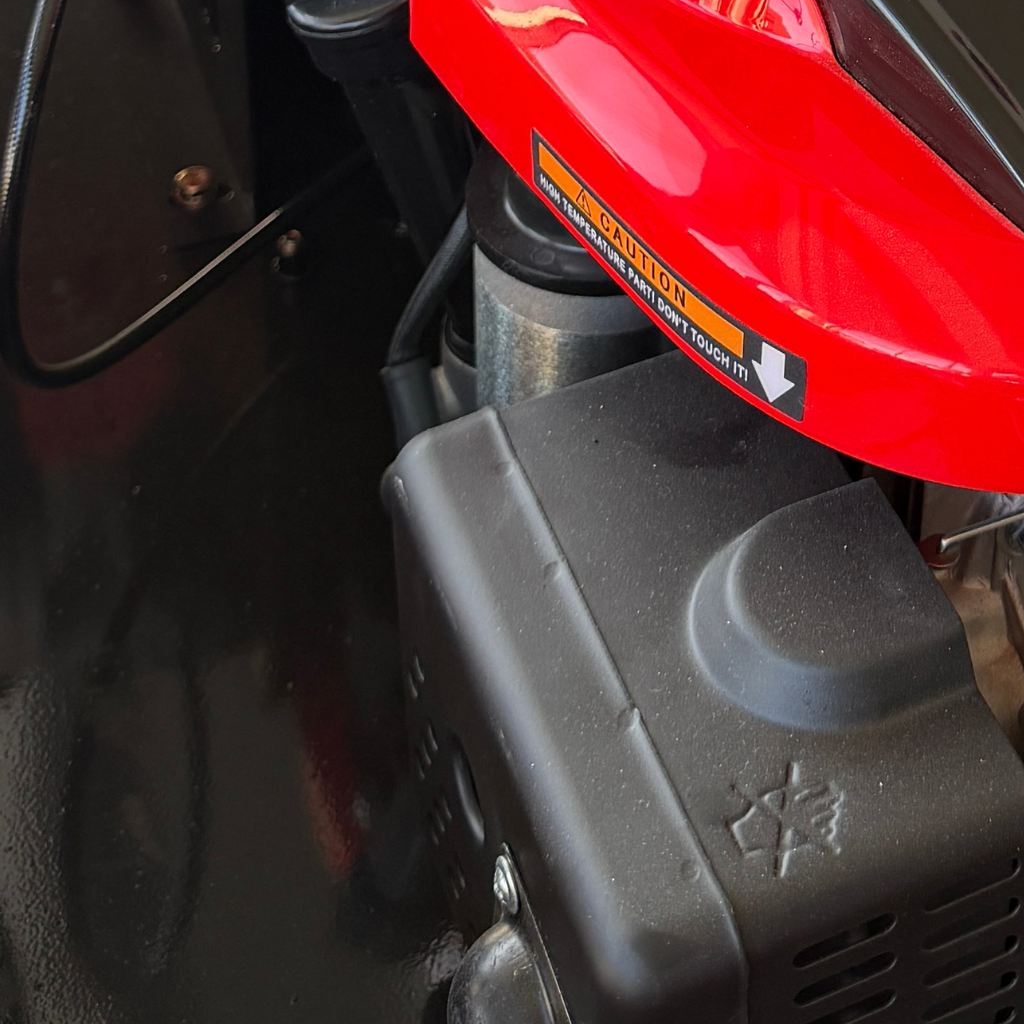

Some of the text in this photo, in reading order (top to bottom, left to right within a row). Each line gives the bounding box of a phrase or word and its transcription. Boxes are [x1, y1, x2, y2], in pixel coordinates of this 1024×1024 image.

[539, 172, 561, 205] HIGH
[561, 196, 626, 276] TEMPERATURE
[657, 296, 689, 335] DON'T
[690, 326, 730, 372] TOUCH
[732, 360, 749, 383] IT!
[600, 211, 687, 309] CAUTION
